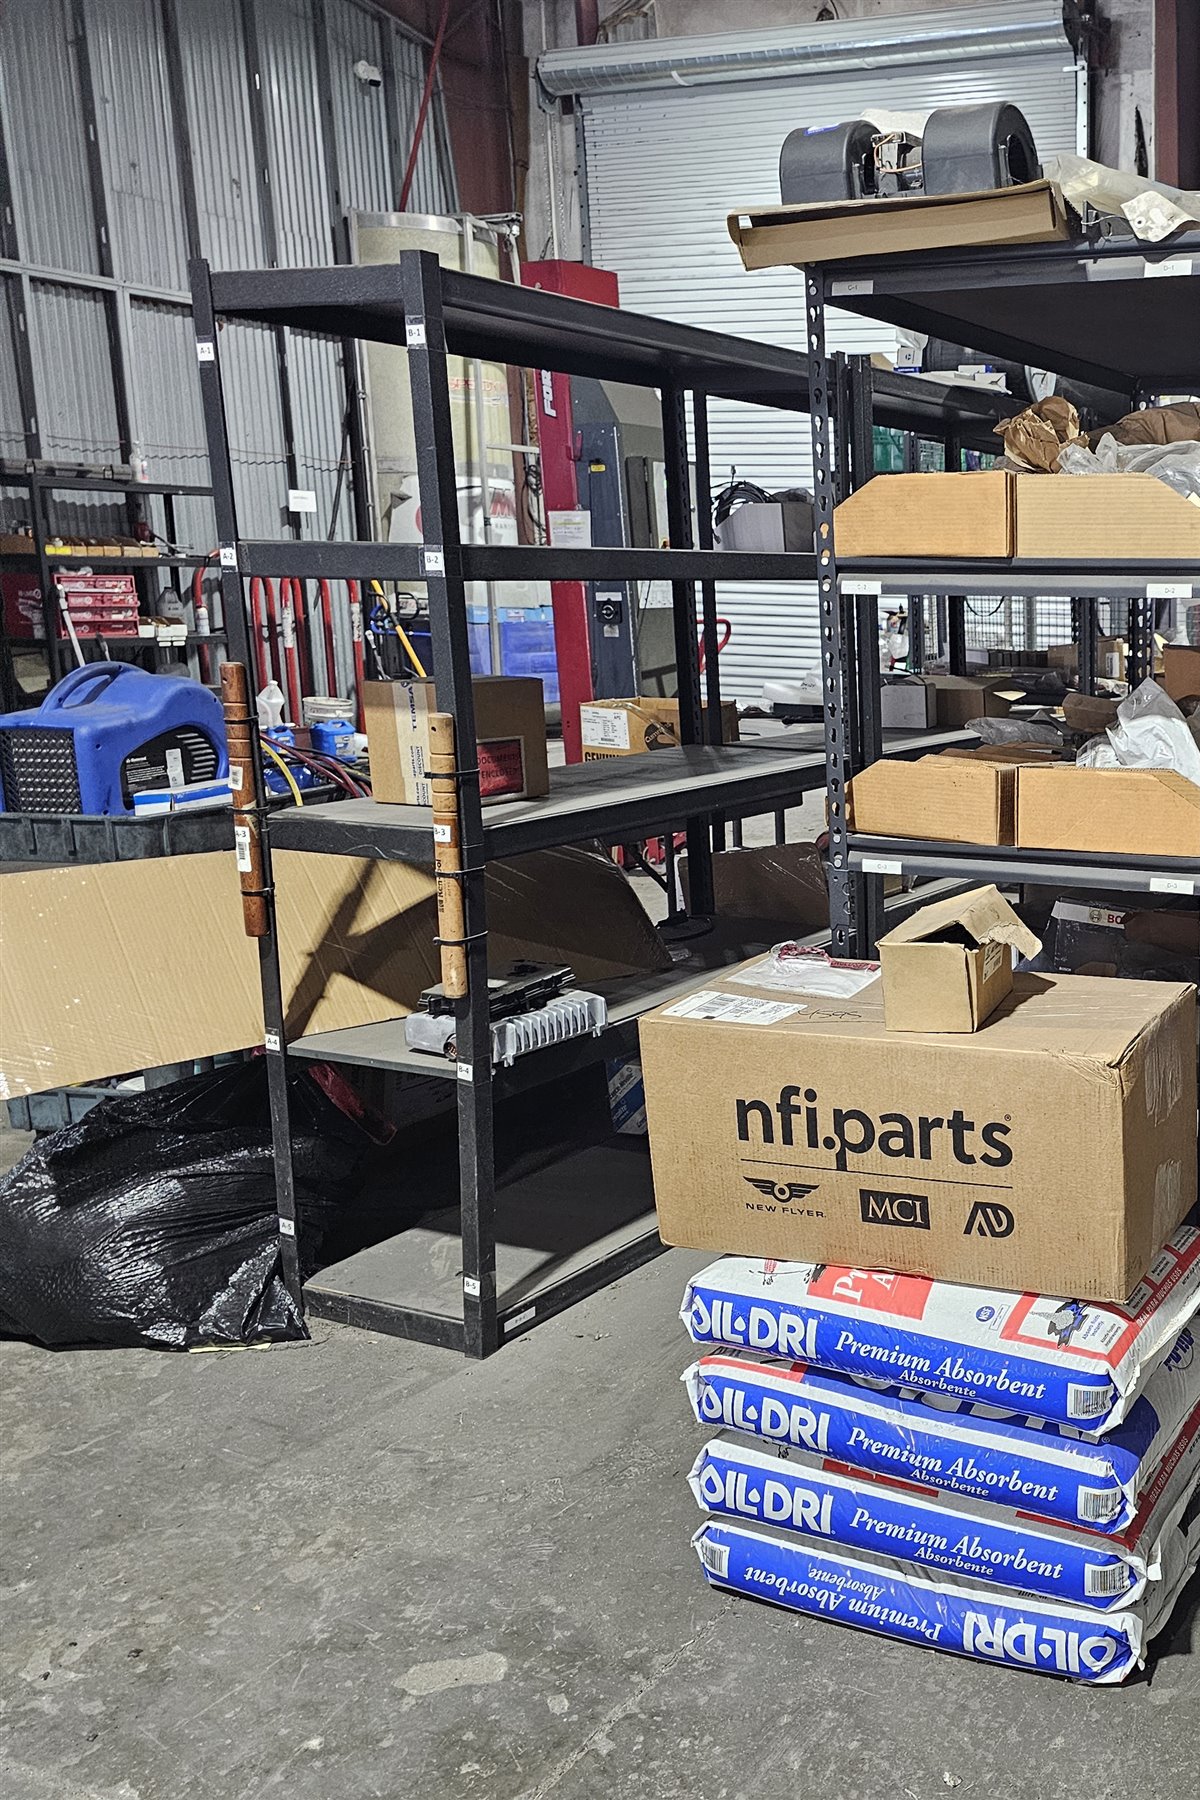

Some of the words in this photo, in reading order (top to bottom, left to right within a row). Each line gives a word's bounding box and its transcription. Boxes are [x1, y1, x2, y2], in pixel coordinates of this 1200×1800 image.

[222, 552, 233, 560] A-2
[459, 1065, 469, 1074] B-4
[736, 1085, 1014, 1172] nfi.parts
[745, 1202, 778, 1214] NEW
[782, 1206, 824, 1218] FLYER
[866, 1195, 924, 1224] MCI
[281, 1221, 292, 1229] A-5
[466, 1280, 477, 1288] B-5
[835, 1330, 931, 1372] Premium
[933, 1356, 1047, 1399] Absorbent
[898, 1368, 977, 1397] Absorbente
[847, 1426, 943, 1473] Premium
[945, 1457, 1059, 1502] Absorbent
[910, 1469, 989, 1497] Absorbente
[849, 1507, 947, 1550] Premium
[950, 1535, 1063, 1580] Absorbent
[914, 1546, 994, 1576] Absorbente
[743, 1566, 846, 1611] Absorbent
[808, 1567, 886, 1601] Absorbente
[848, 1597, 945, 1642] Premium
